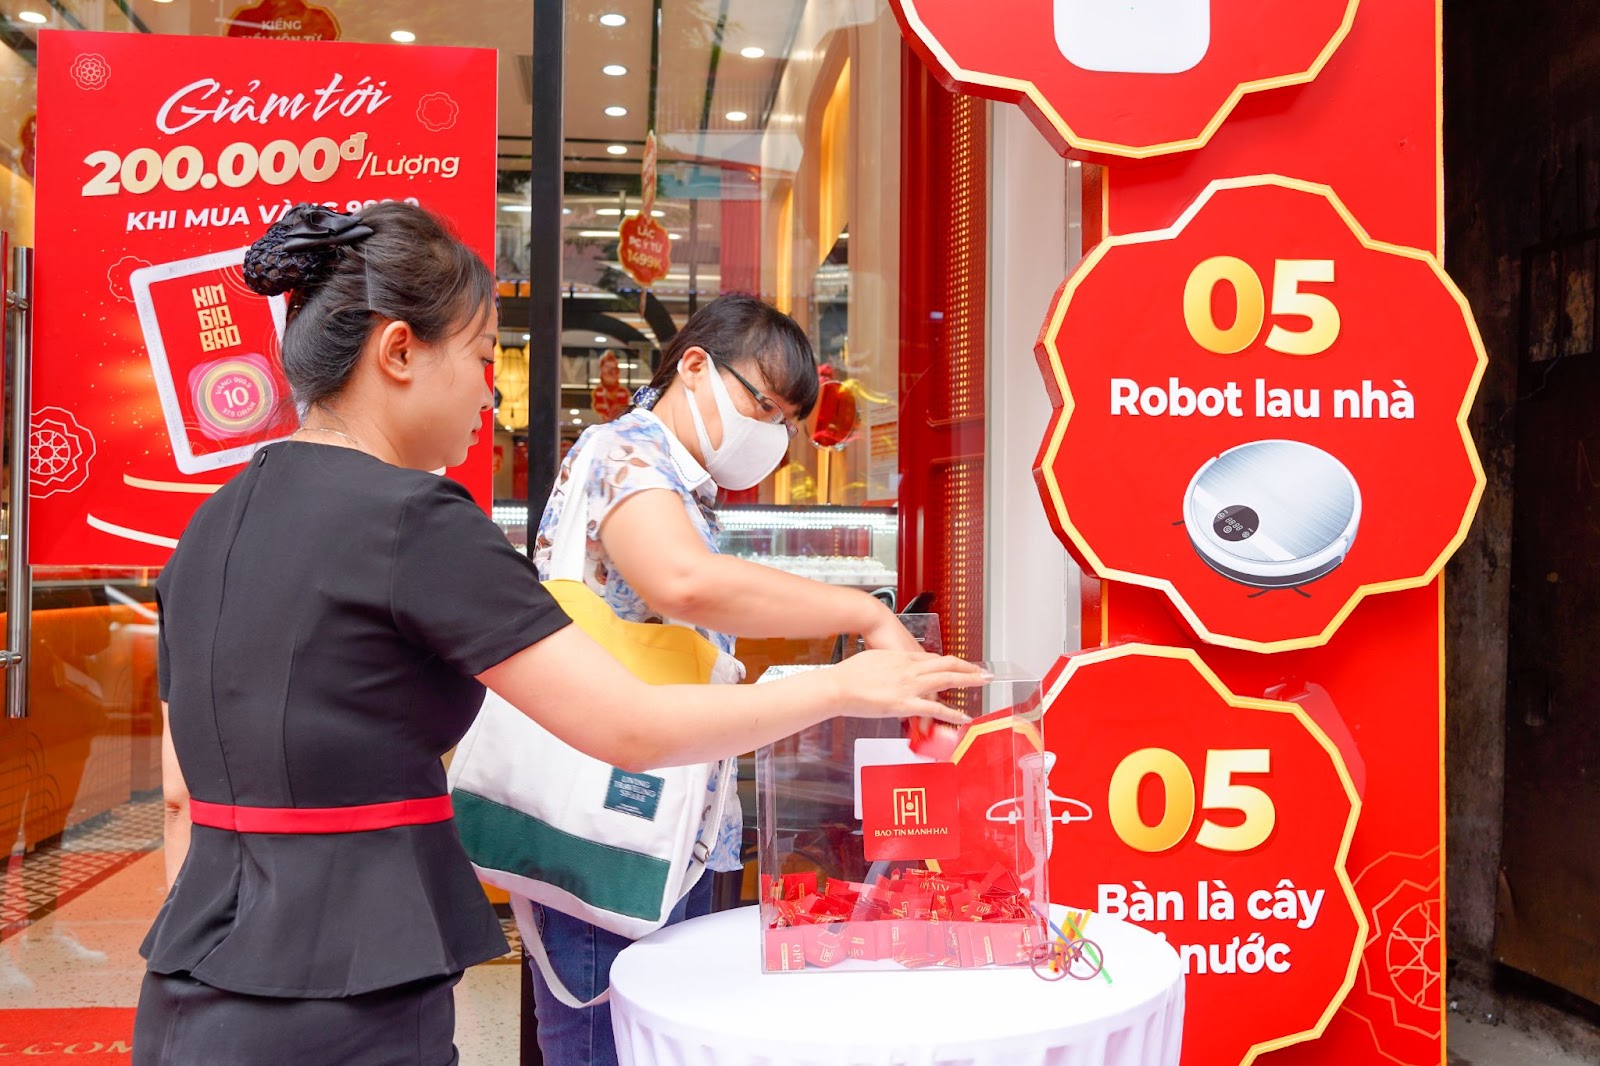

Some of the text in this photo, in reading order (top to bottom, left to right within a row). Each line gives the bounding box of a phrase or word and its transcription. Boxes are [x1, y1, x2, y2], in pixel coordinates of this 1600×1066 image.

[156, 72, 392, 135] Giảm tới
[126, 209, 176, 232] KHI
[184, 206, 251, 229] MUA
[258, 199, 339, 224] VÀG
[192, 283, 227, 309] KIM
[1183, 255, 1341, 356] 05
[197, 305, 232, 331] GIA
[223, 386, 249, 409] 10
[1110, 377, 1415, 419] Robot lau nhà
[1108, 747, 1276, 853] 05
[1097, 879, 1325, 929] Bàn là cây
[1179, 932, 1291, 975] nước
